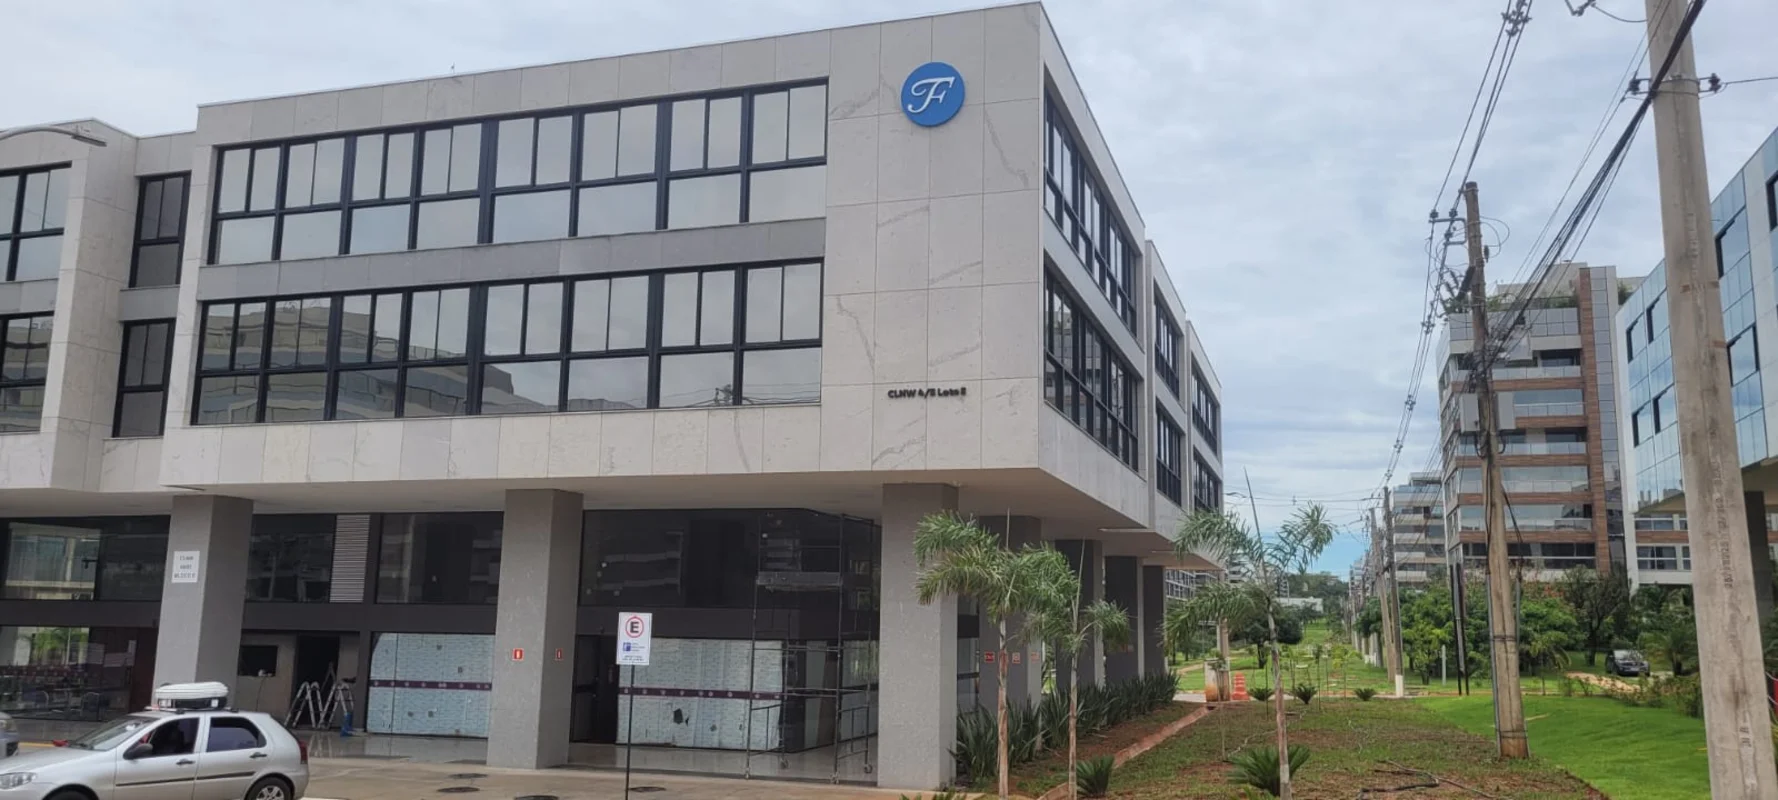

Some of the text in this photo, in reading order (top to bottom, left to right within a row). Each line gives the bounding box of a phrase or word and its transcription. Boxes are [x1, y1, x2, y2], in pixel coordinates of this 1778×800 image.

[907, 76, 956, 113] F
[887, 389, 916, 399] CLNW
[630, 622, 639, 633] E
